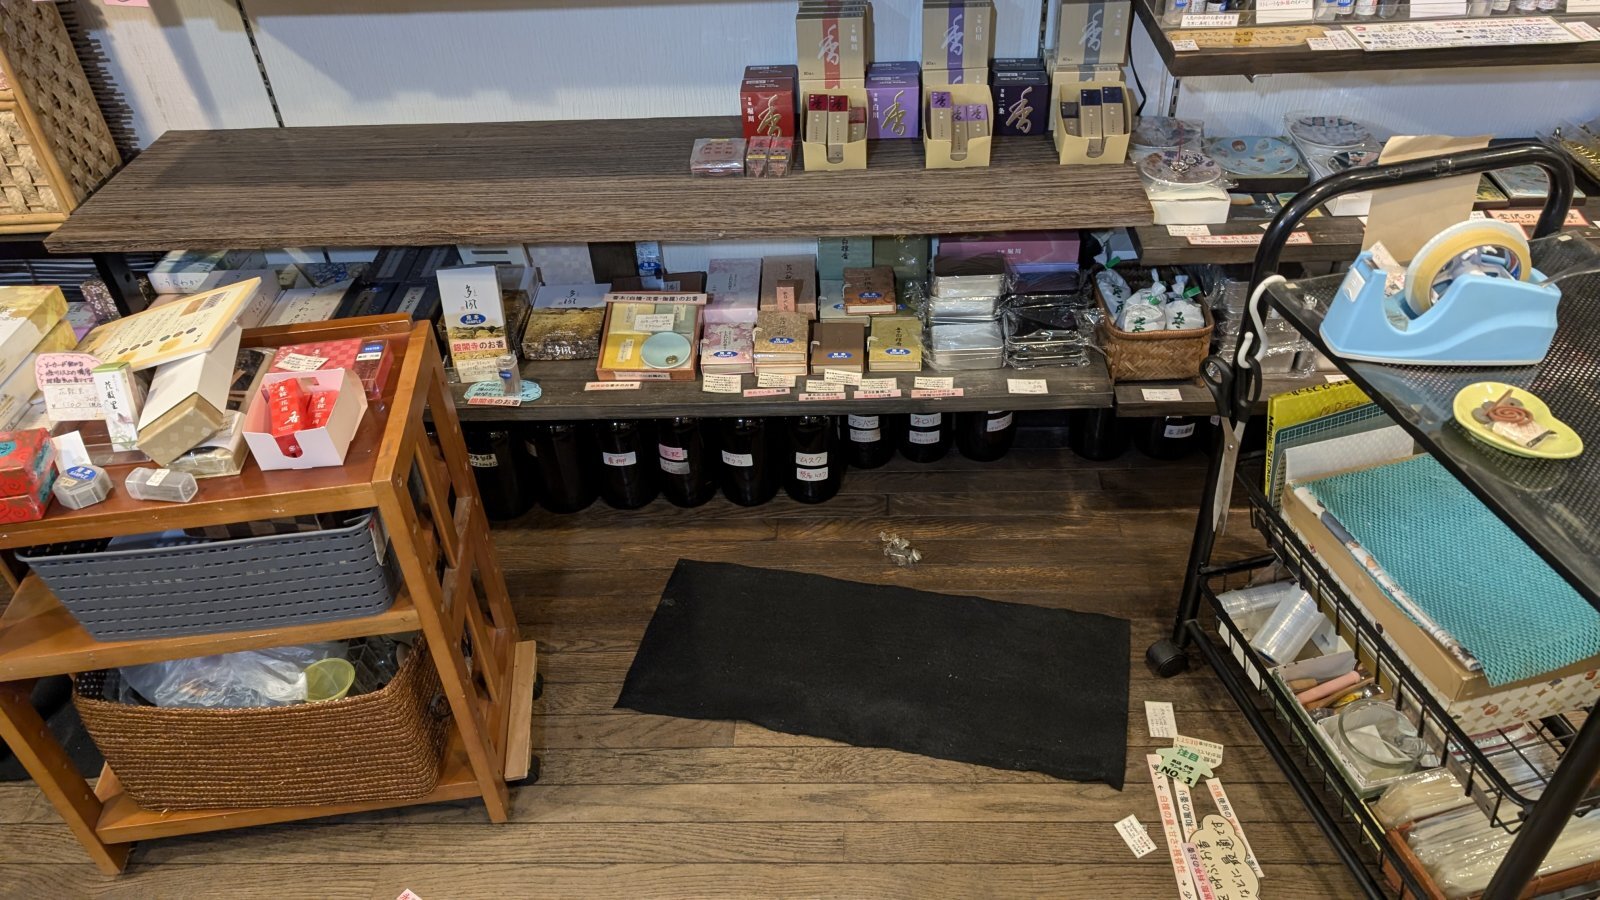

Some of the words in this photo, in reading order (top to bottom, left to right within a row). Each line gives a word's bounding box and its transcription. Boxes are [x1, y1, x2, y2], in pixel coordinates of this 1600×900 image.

[453, 340, 504, 352] 銀閣寺のお香
[1177, 748, 1199, 763] 注目
[1184, 777, 1193, 785] 3
